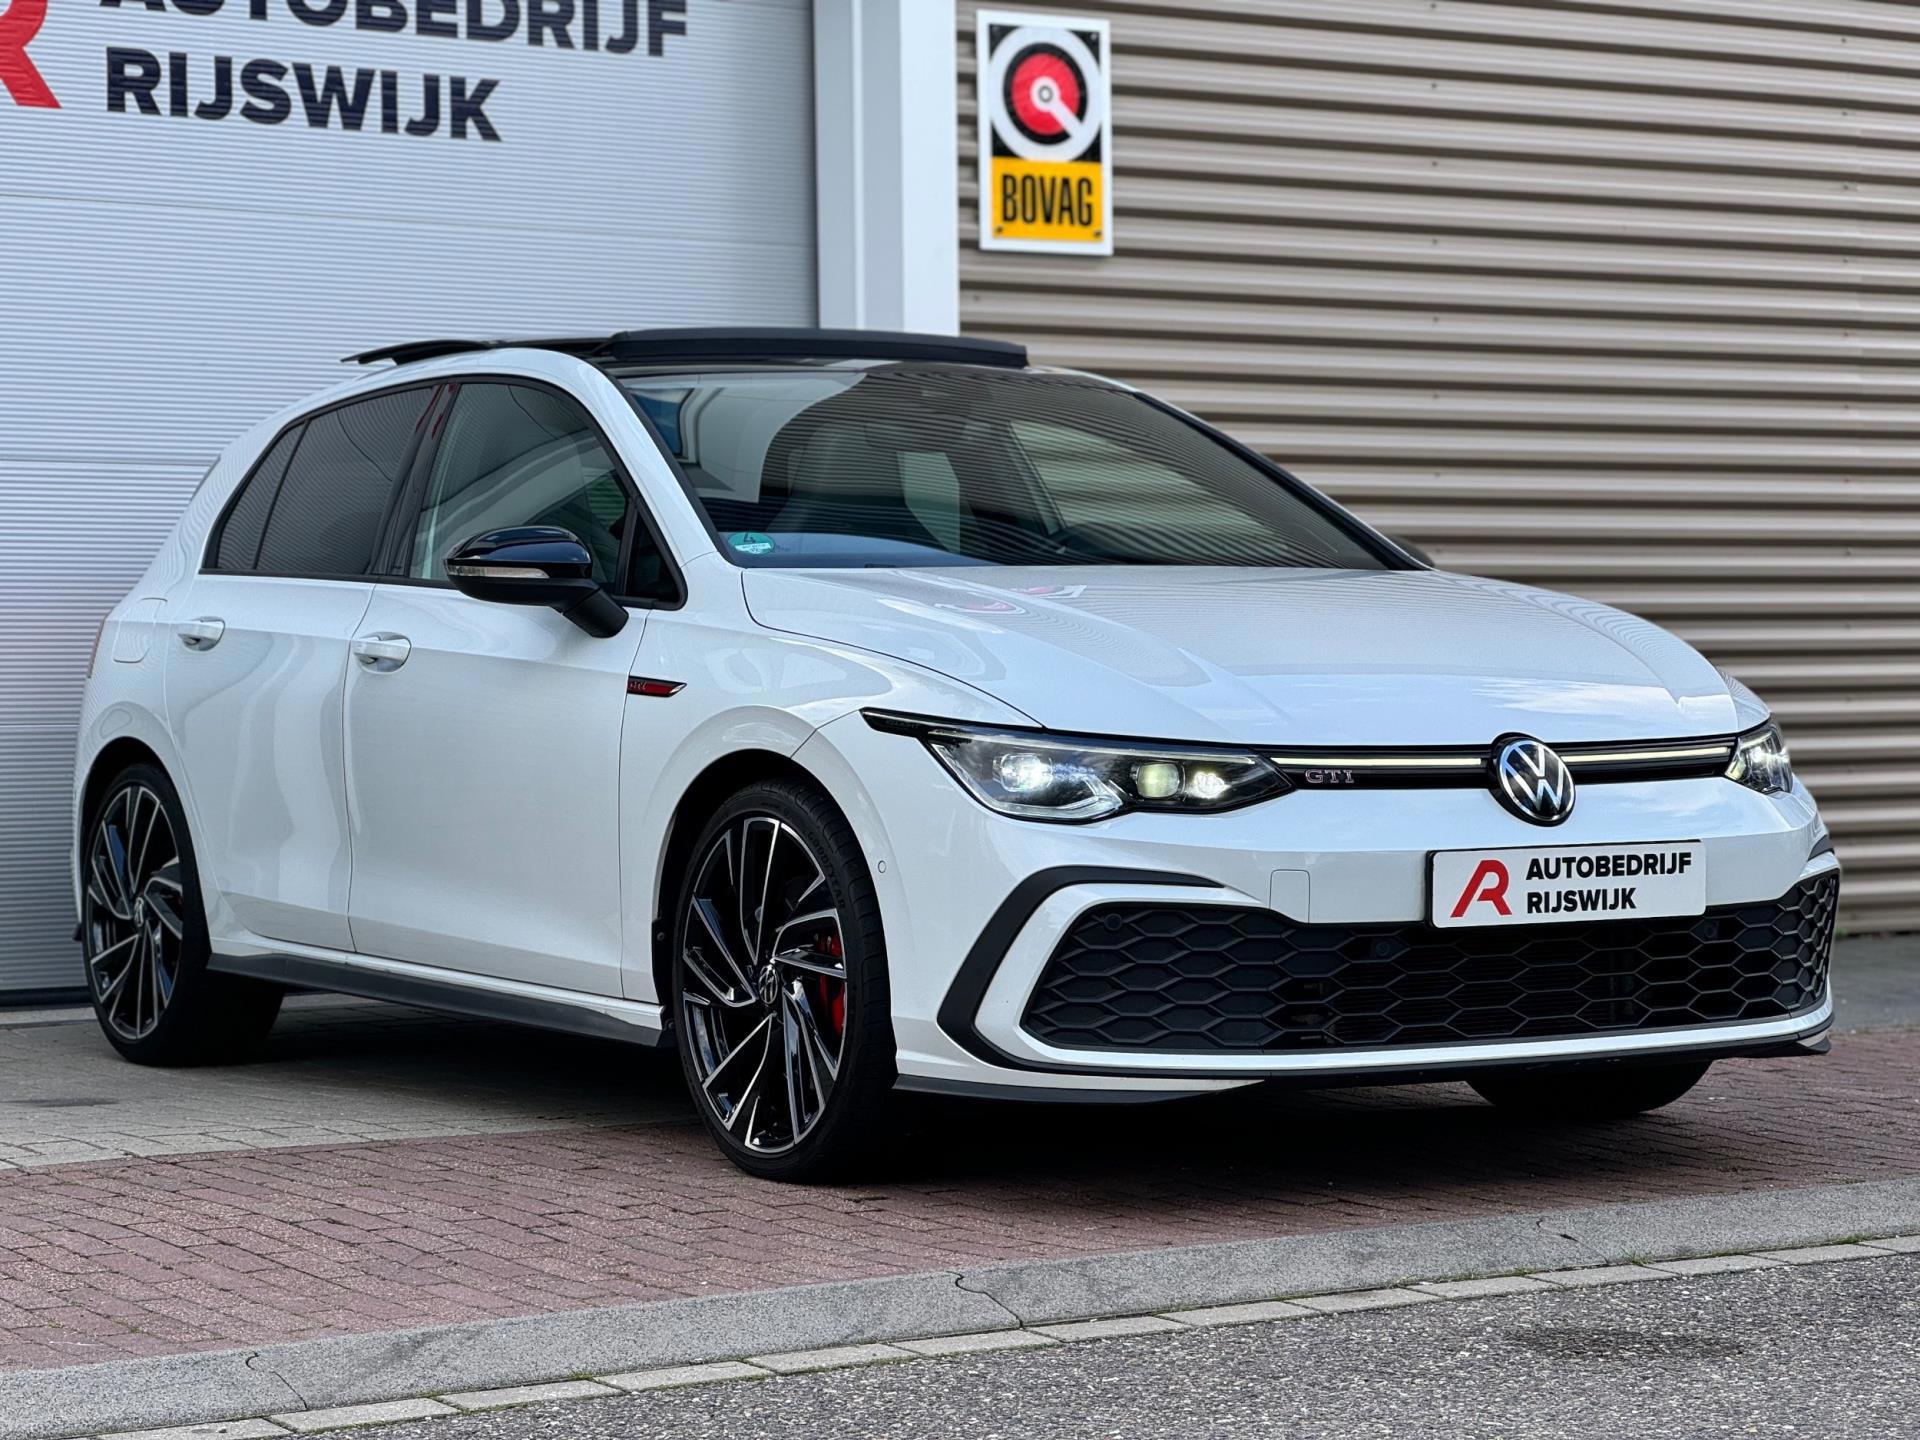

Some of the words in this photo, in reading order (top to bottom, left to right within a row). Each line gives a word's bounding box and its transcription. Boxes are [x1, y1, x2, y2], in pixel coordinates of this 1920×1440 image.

[99, 0, 687, 57] BEDRIJF
[105, 46, 501, 141] RIJSWIJK
[1002, 174, 1093, 226] BOVAG
[1304, 769, 1355, 784] GTI
[1525, 851, 1692, 880] AUTOBEDRIJF
[1526, 887, 1637, 914] RIJSWIJK
